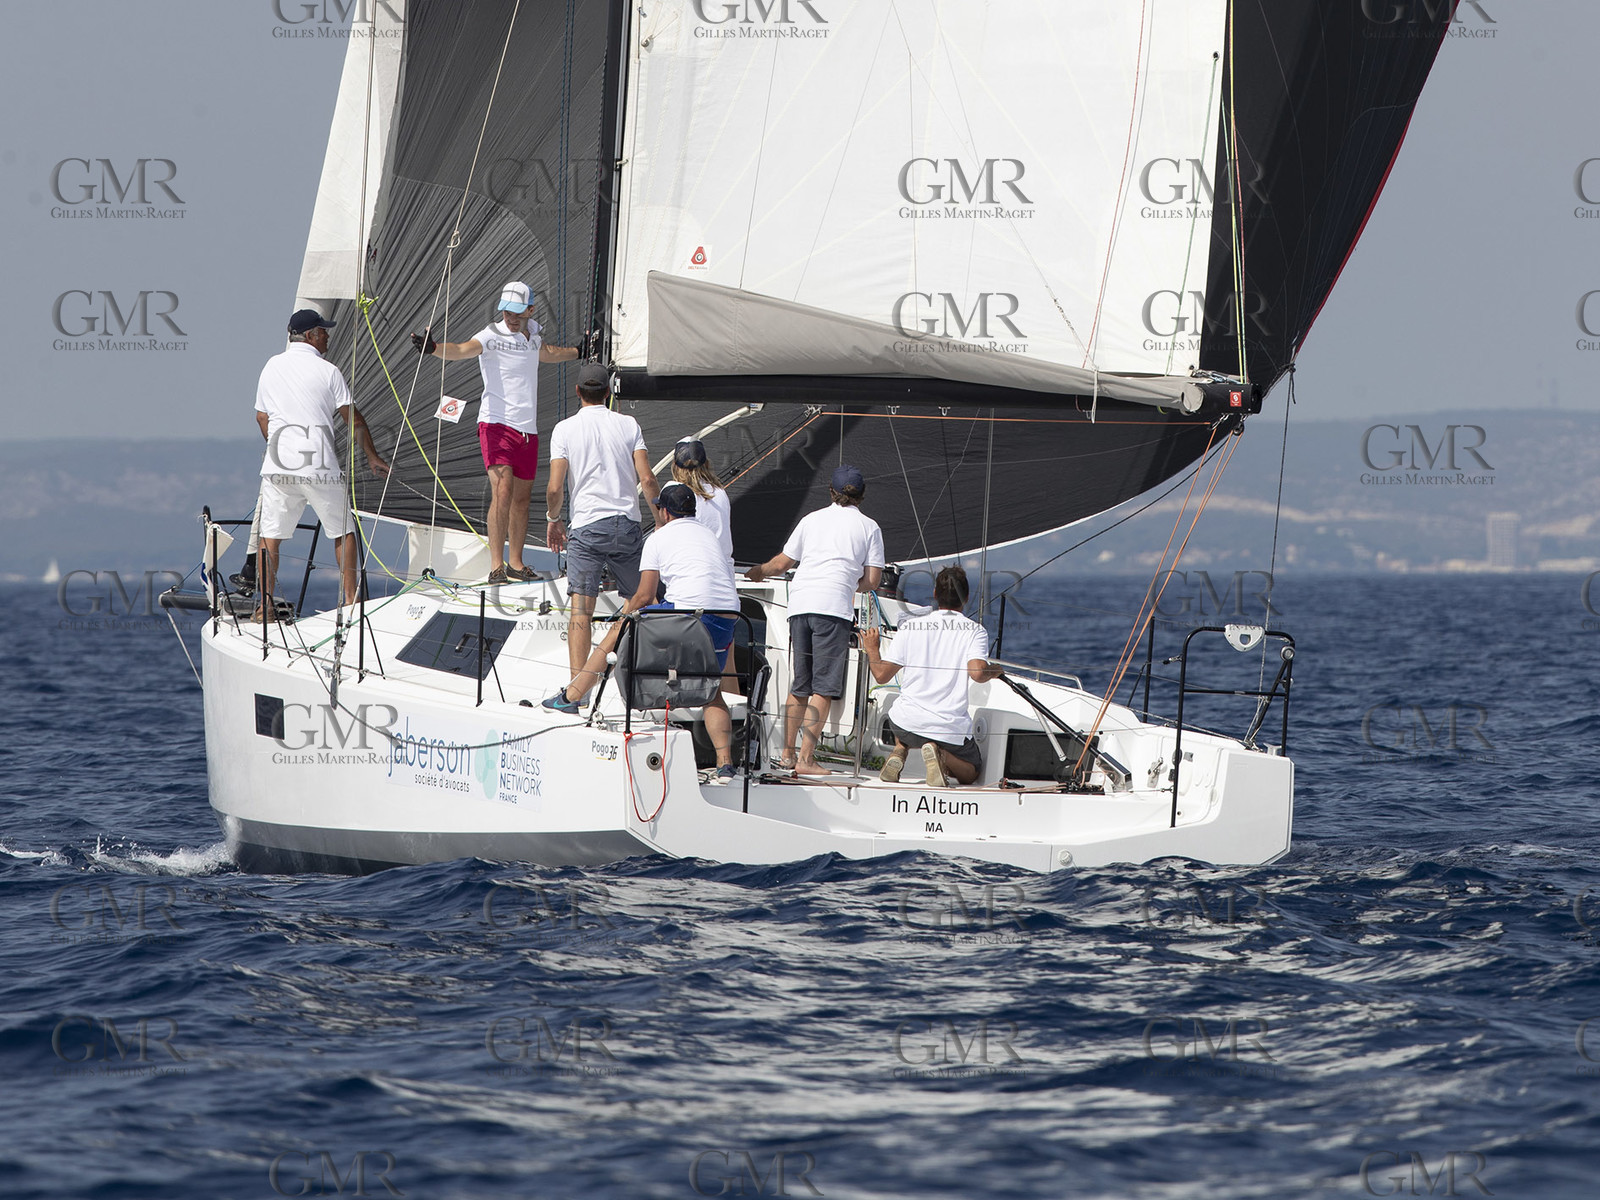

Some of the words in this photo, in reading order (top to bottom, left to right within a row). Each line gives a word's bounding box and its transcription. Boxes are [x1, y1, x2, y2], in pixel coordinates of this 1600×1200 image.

[502, 731, 532, 753] FAMILY
[591, 740, 609, 756] Pogo
[501, 752, 541, 776] BUSINESS
[500, 772, 542, 797] NETWORK
[499, 792, 518, 804] FRANCE
[892, 794, 909, 813] In
[916, 795, 979, 816] Altum
[925, 822, 944, 833] MA
